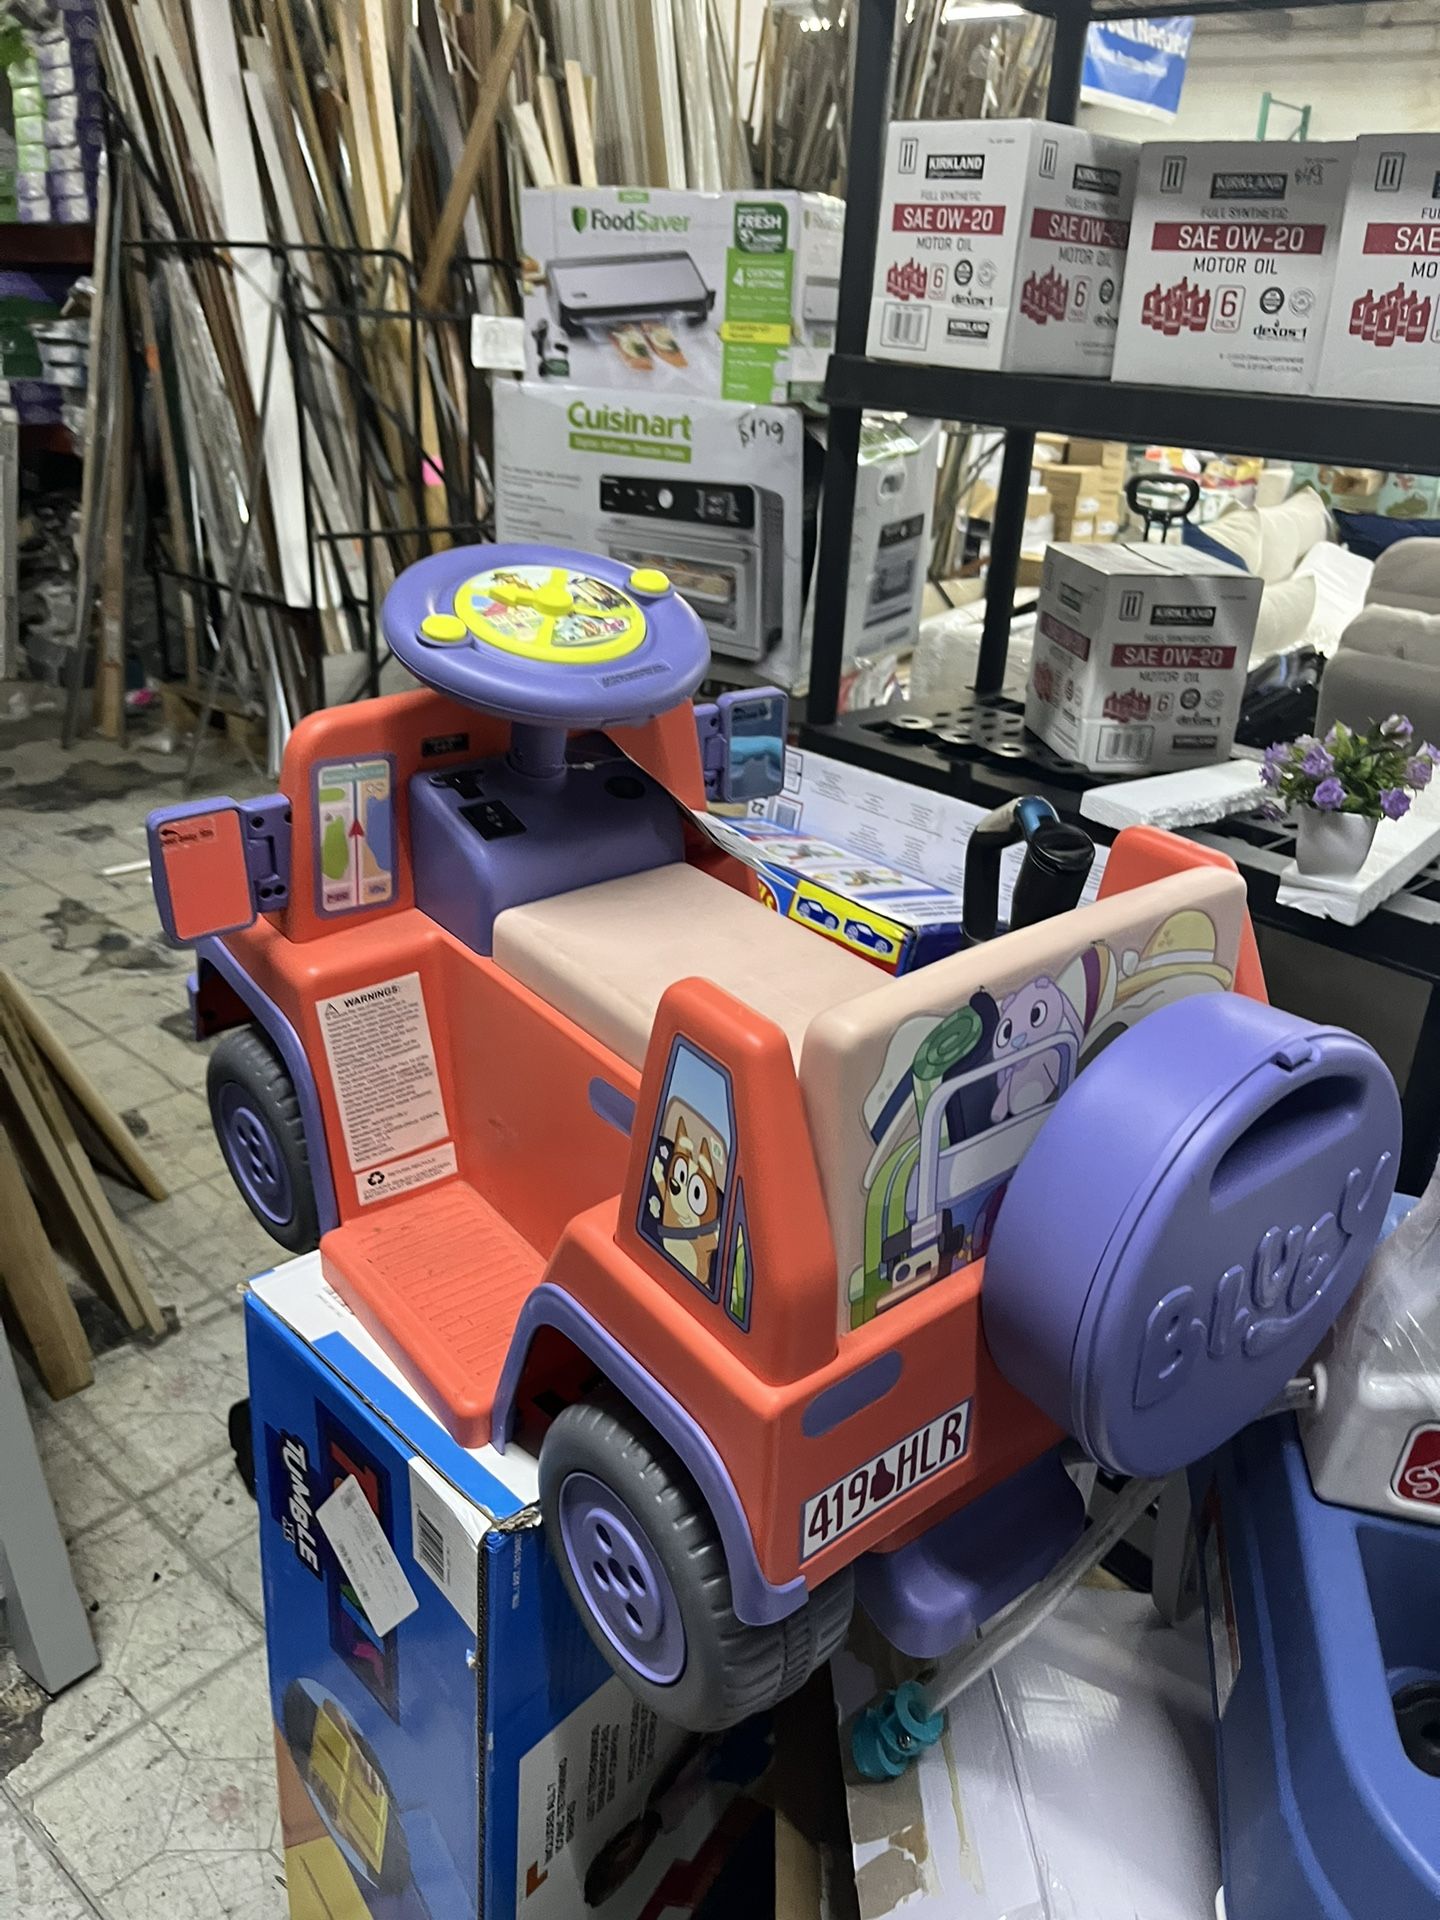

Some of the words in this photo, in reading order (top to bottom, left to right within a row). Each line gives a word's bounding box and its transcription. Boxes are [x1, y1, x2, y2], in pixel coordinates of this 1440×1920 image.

[928, 157, 983, 170] KIRKLAND
[1215, 176, 1285, 190] KIRKLAND
[592, 208, 691, 232] FoodSaver
[737, 214, 782, 229] FRESH
[902, 207, 933, 229] SAE
[937, 208, 993, 231] 0W-20
[1229, 207, 1289, 219] SYNTHETIC
[1049, 214, 1079, 240] SAE
[916, 236, 952, 249] MOTOR
[956, 238, 973, 252] OIL
[1178, 225, 1220, 249] SAE
[1225, 226, 1304, 251] 0W-20
[1395, 227, 1440, 252] SAE
[1193, 257, 1247, 274] MOTOR
[1254, 258, 1278, 275] OIL
[933, 268, 944, 288] 6
[1075, 281, 1086, 307] 6
[1220, 290, 1238, 318] 6
[567, 401, 692, 441] Cuisinart
[1155, 608, 1213, 619] KIRKLAND
[1123, 648, 1159, 665] SAE
[1162, 648, 1223, 666] 0W-20
[1139, 671, 1179, 682] MOTOR
[1157, 696, 1168, 712] 6
[808, 1470, 869, 1541] 419
[896, 1412, 962, 1492] HLR
[282, 1438, 320, 1572] TUMBLE
